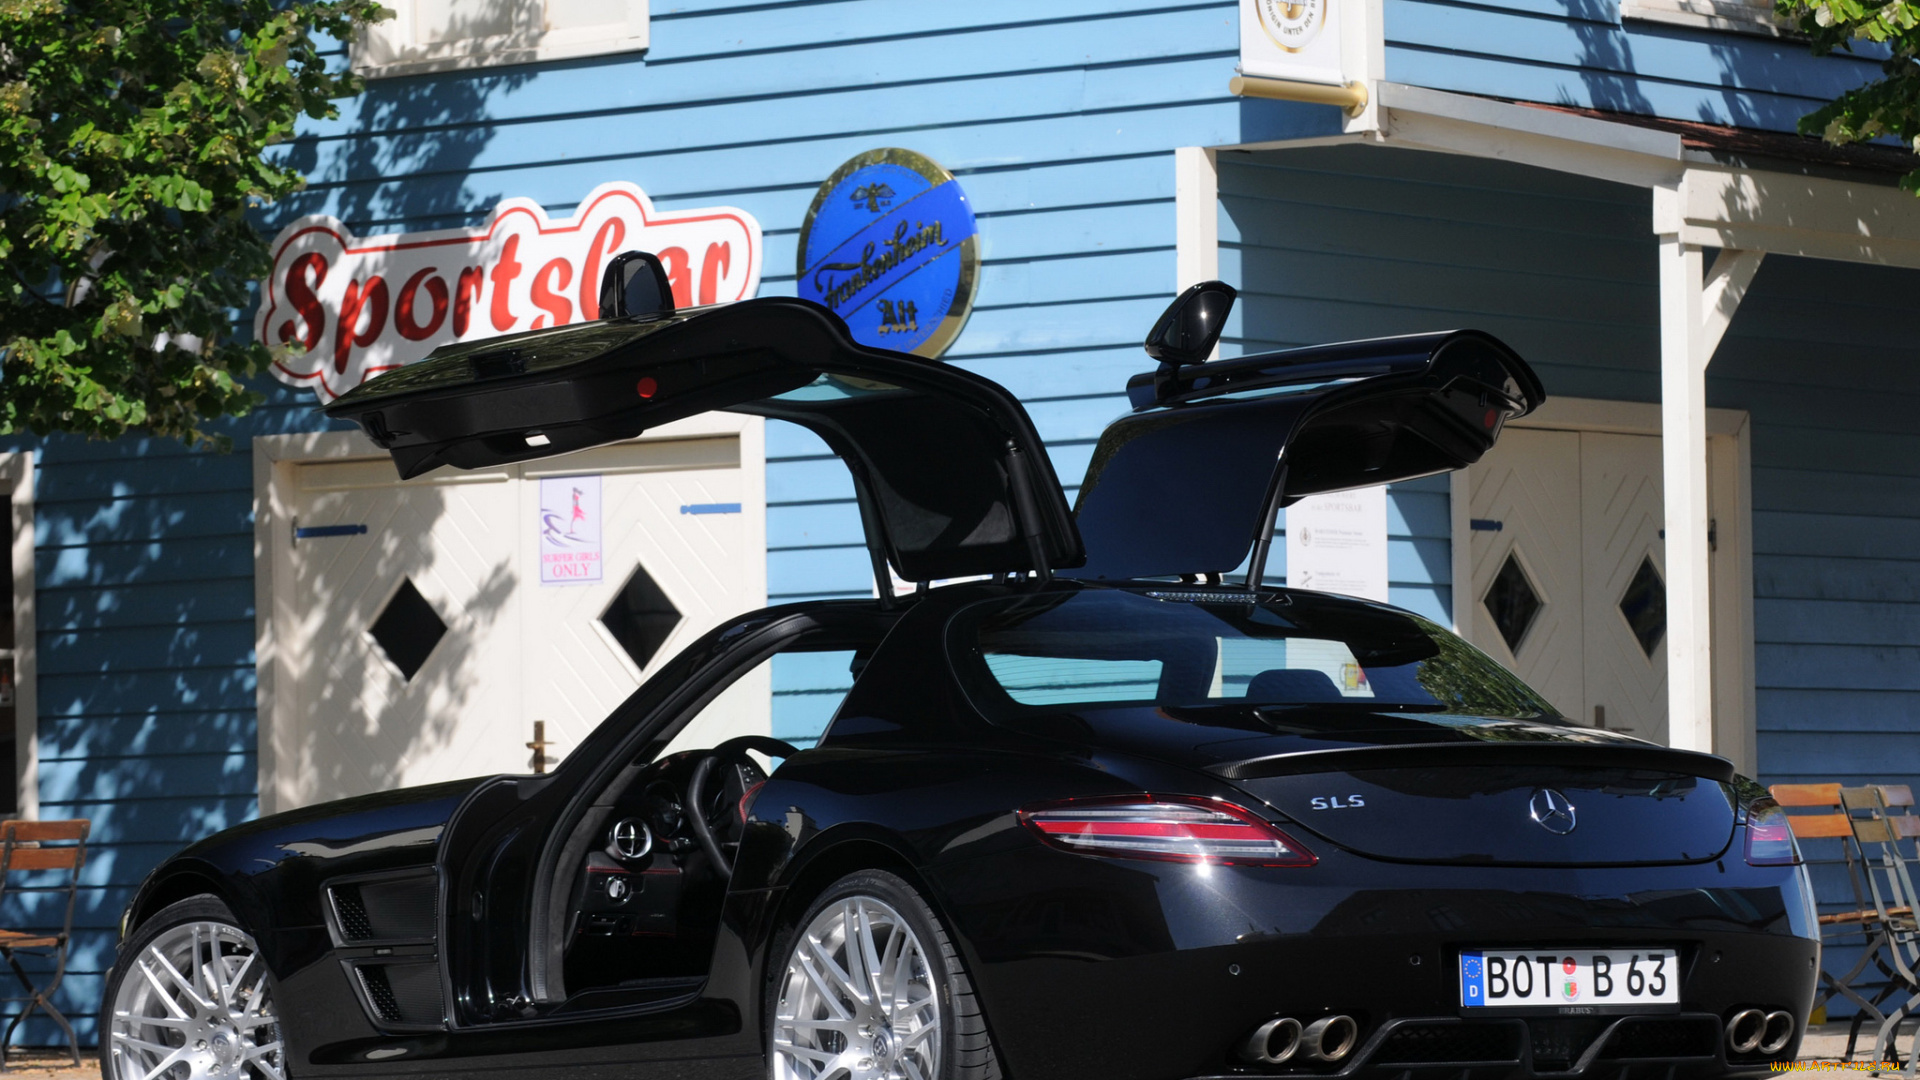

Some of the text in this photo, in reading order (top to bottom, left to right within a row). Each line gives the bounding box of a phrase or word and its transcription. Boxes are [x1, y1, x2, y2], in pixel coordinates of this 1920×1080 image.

[1283, 26, 1303, 35] UNTER
[1304, 12, 1314, 28] DEN
[876, 298, 919, 338] Alt
[575, 551, 601, 561] GIRLS
[552, 562, 592, 578] ONLY
[1310, 794, 1365, 810] SLS
[1486, 954, 1667, 999] BOT B 63
[1469, 984, 1479, 998] D
